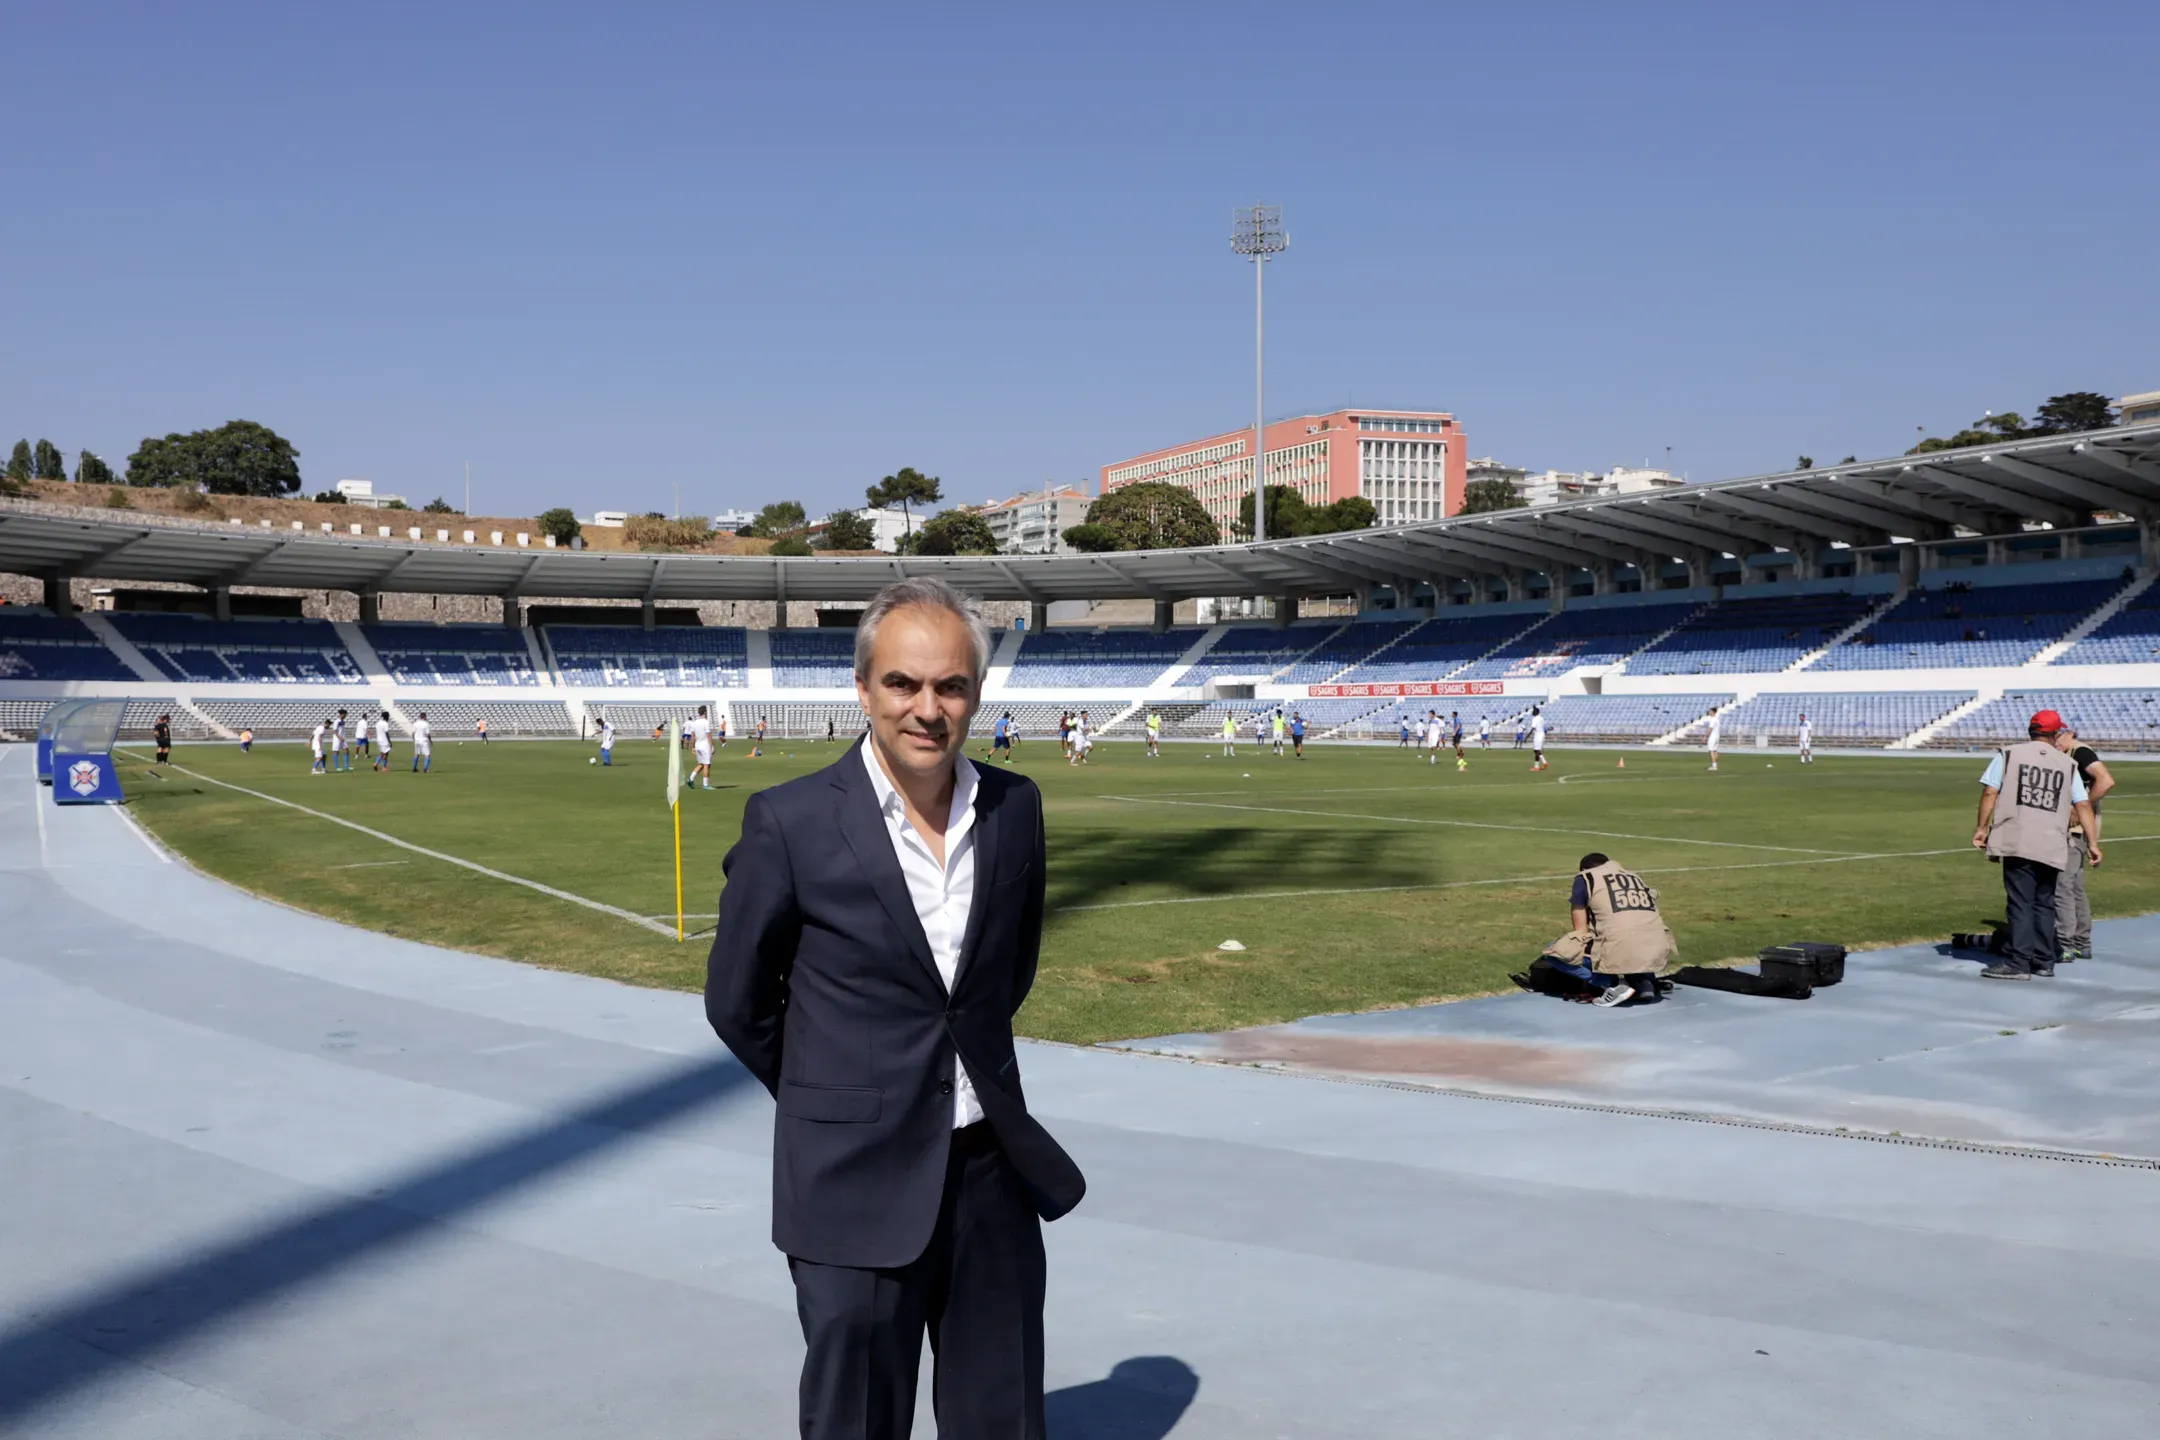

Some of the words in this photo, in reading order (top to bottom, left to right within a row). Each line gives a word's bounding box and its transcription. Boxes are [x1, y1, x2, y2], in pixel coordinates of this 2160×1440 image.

[1317, 686, 1338, 696] SAGRES
[1349, 685, 1368, 695] SAGRES
[1380, 684, 1400, 695] SAGRES
[1411, 684, 1432, 694] SAGRES
[1444, 683, 1466, 694] SAGRES
[1479, 682, 1502, 693] SAGRES
[2018, 764, 2064, 792] FOTO
[2020, 786, 2055, 808] 538
[1614, 889, 1651, 908] 568
